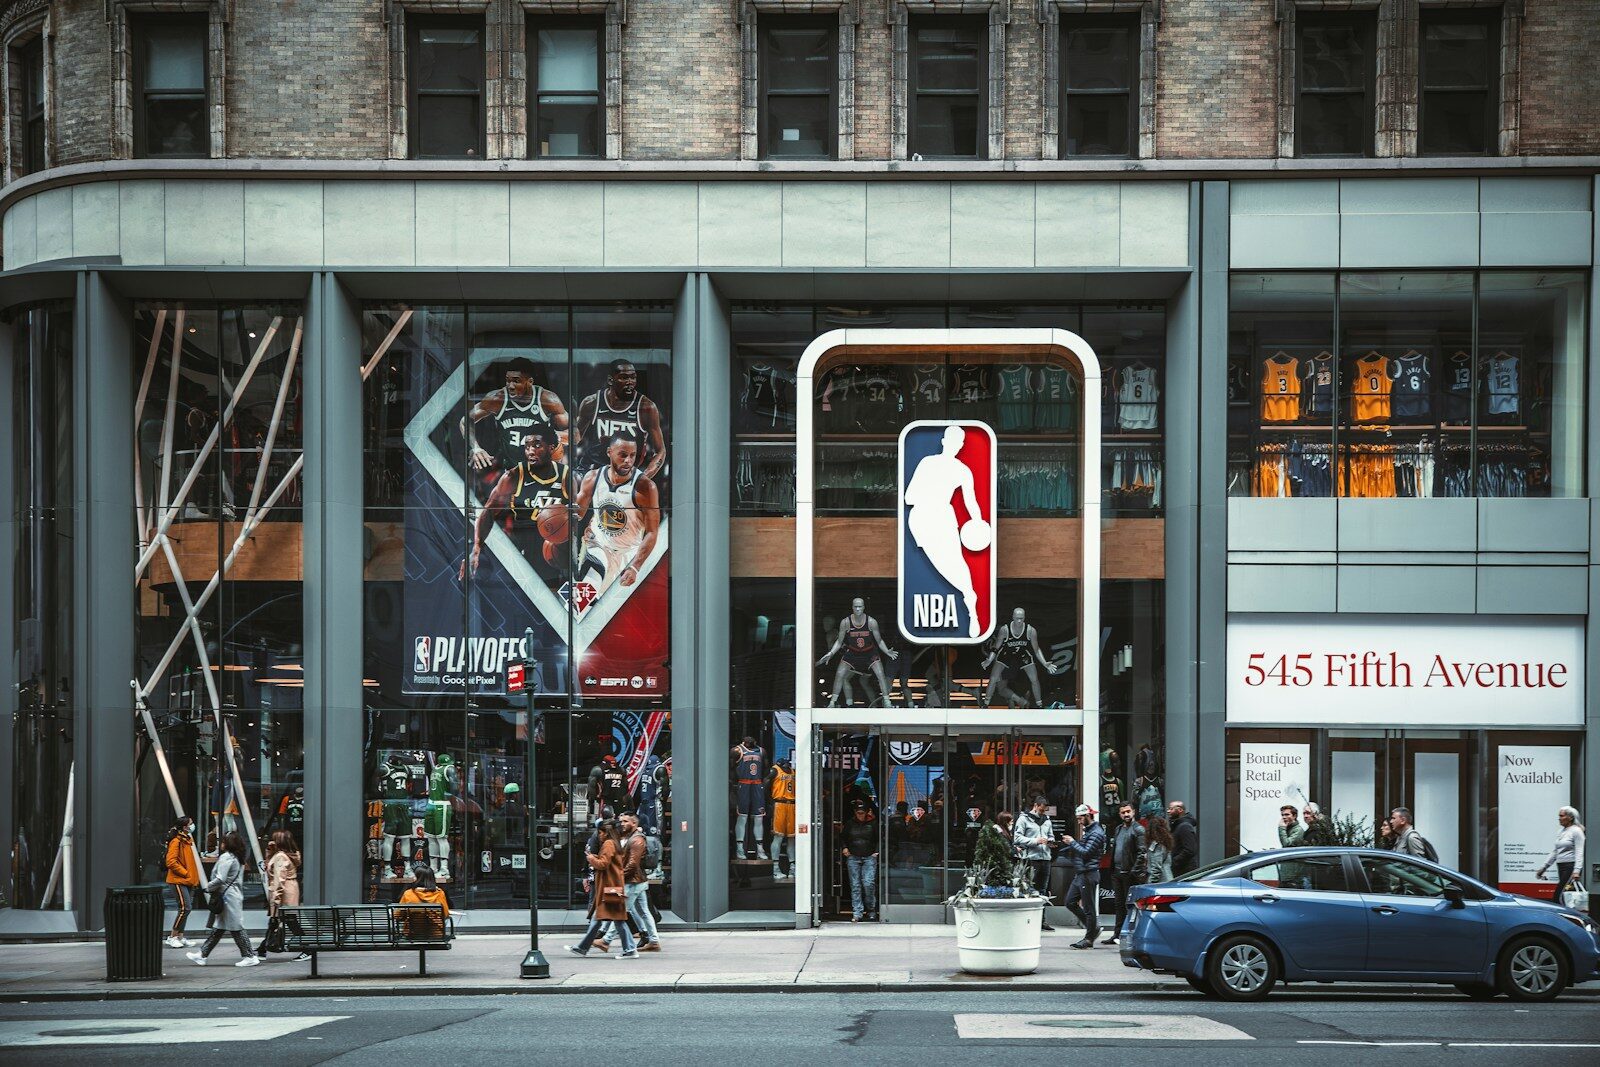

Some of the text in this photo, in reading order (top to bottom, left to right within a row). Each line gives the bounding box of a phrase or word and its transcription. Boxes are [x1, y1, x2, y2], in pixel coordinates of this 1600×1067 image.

[1279, 378, 1288, 392] 3
[1410, 375, 1420, 391] 6
[754, 383, 763, 398] 7
[869, 388, 885, 401] 34
[1134, 384, 1142, 398] 6
[500, 418, 541, 430] MILWAUK
[613, 511, 623, 520] 30
[914, 594, 958, 628] NBA
[1245, 651, 1568, 688] 545 Fifth Avenue
[475, 676, 496, 684] Pixel
[600, 678, 628, 686] ESPN
[1246, 752, 1302, 766] Boutique
[1504, 755, 1534, 766] Now
[1246, 769, 1281, 781] Retail
[1504, 772, 1563, 784] Available
[395, 779, 406, 790] 34
[1245, 787, 1281, 800] Space
